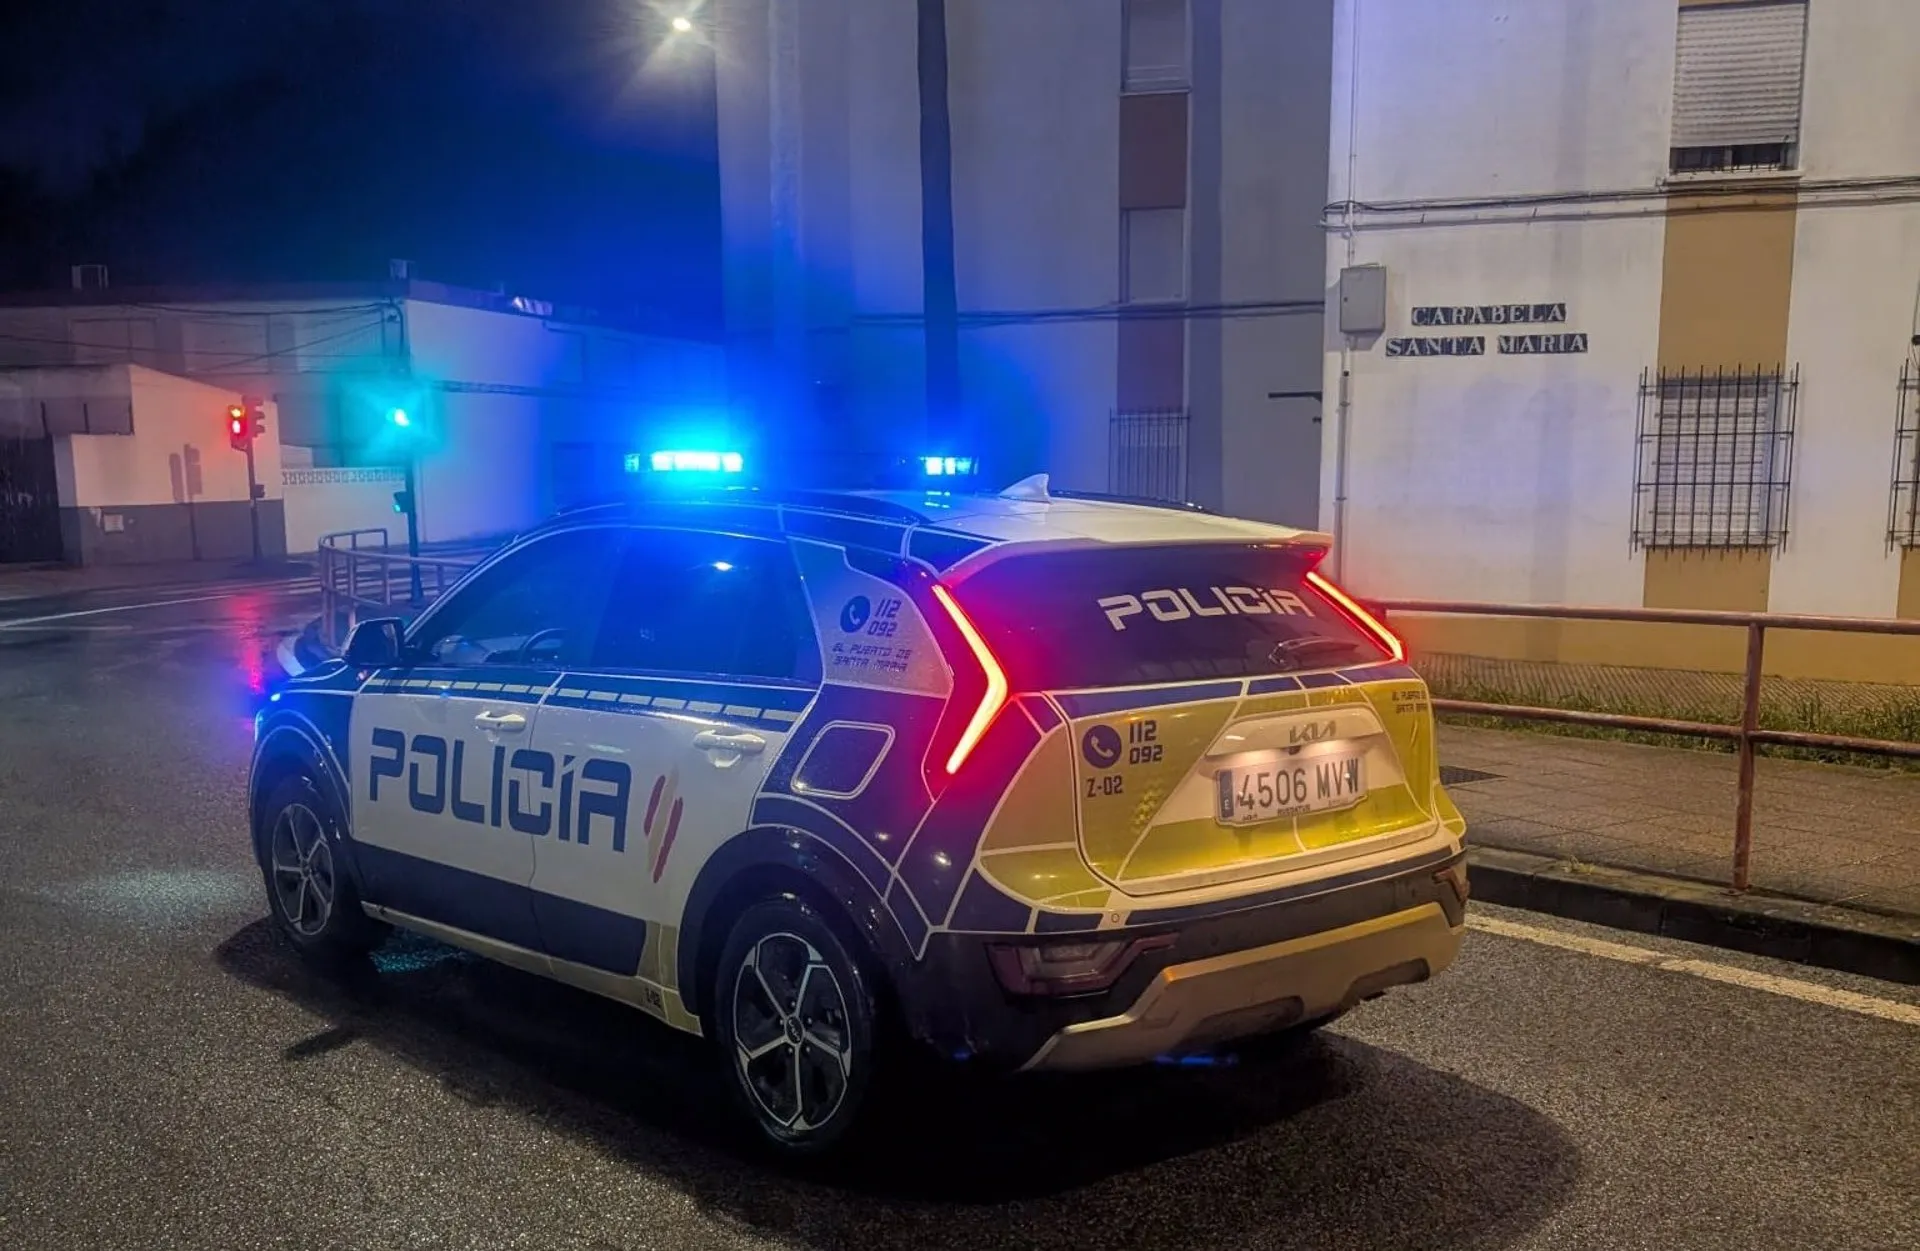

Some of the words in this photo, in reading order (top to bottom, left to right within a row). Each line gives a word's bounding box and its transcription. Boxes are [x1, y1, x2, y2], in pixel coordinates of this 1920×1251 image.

[1411, 303, 1565, 326] CARABELA
[1386, 336, 1485, 356] SANTA
[1498, 333, 1588, 354] MARIA
[874, 598, 902, 619] 112
[866, 620, 898, 637] 092
[1129, 720, 1157, 743] 112
[1289, 720, 1336, 744] KIA
[1129, 745, 1163, 765] 092
[370, 727, 632, 852] POLICÍA
[1086, 776, 1123, 798] Z-02
[1236, 768, 1308, 810] 4506
